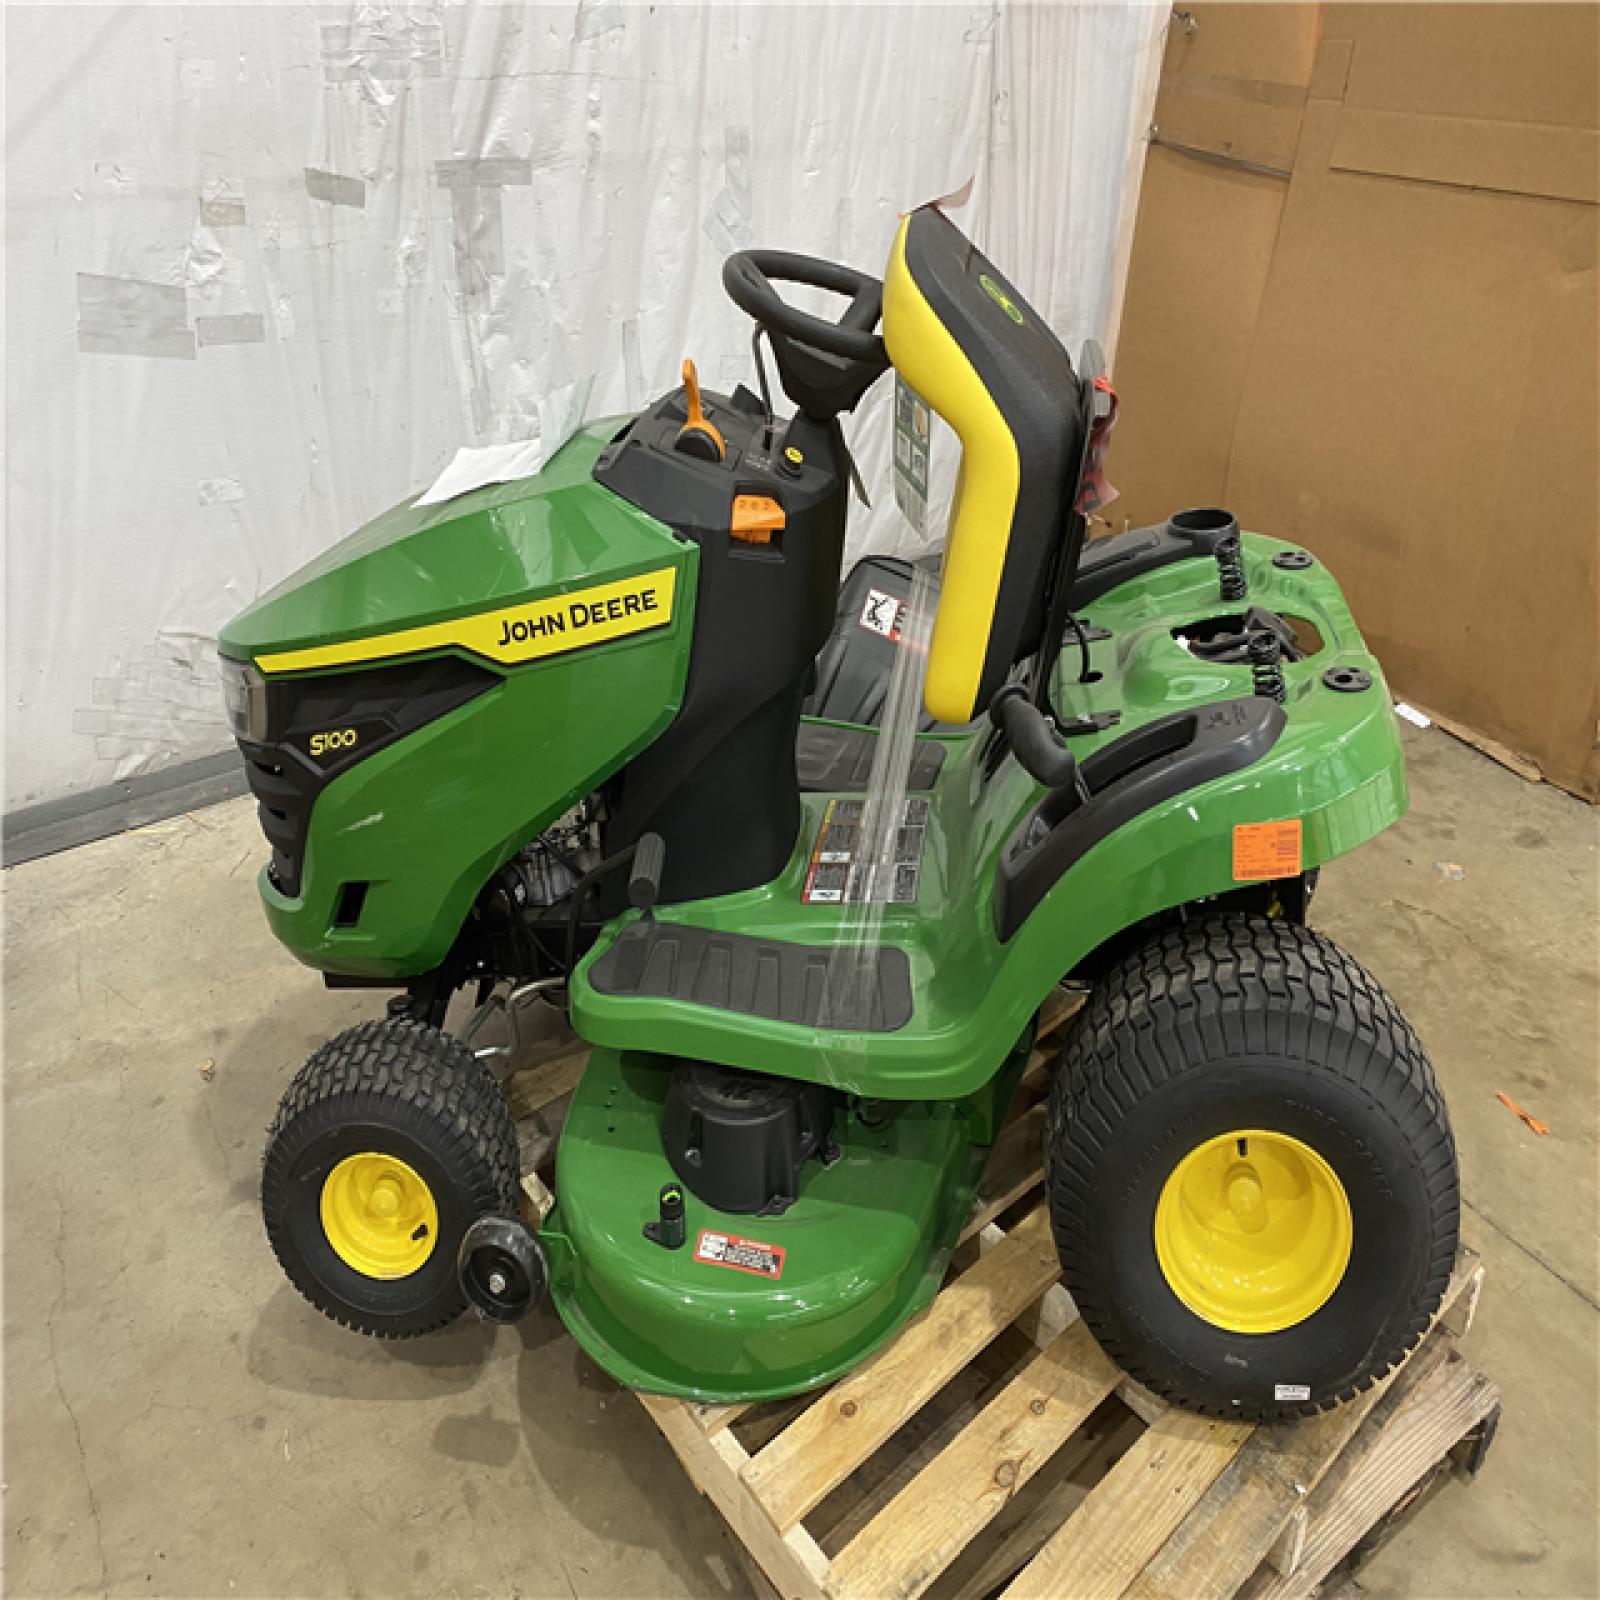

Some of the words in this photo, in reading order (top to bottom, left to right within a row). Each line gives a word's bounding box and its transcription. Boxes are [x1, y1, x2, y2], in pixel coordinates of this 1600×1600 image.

[498, 611, 566, 646] JOHN
[569, 589, 658, 628] DEERE
[309, 729, 356, 756] S100
